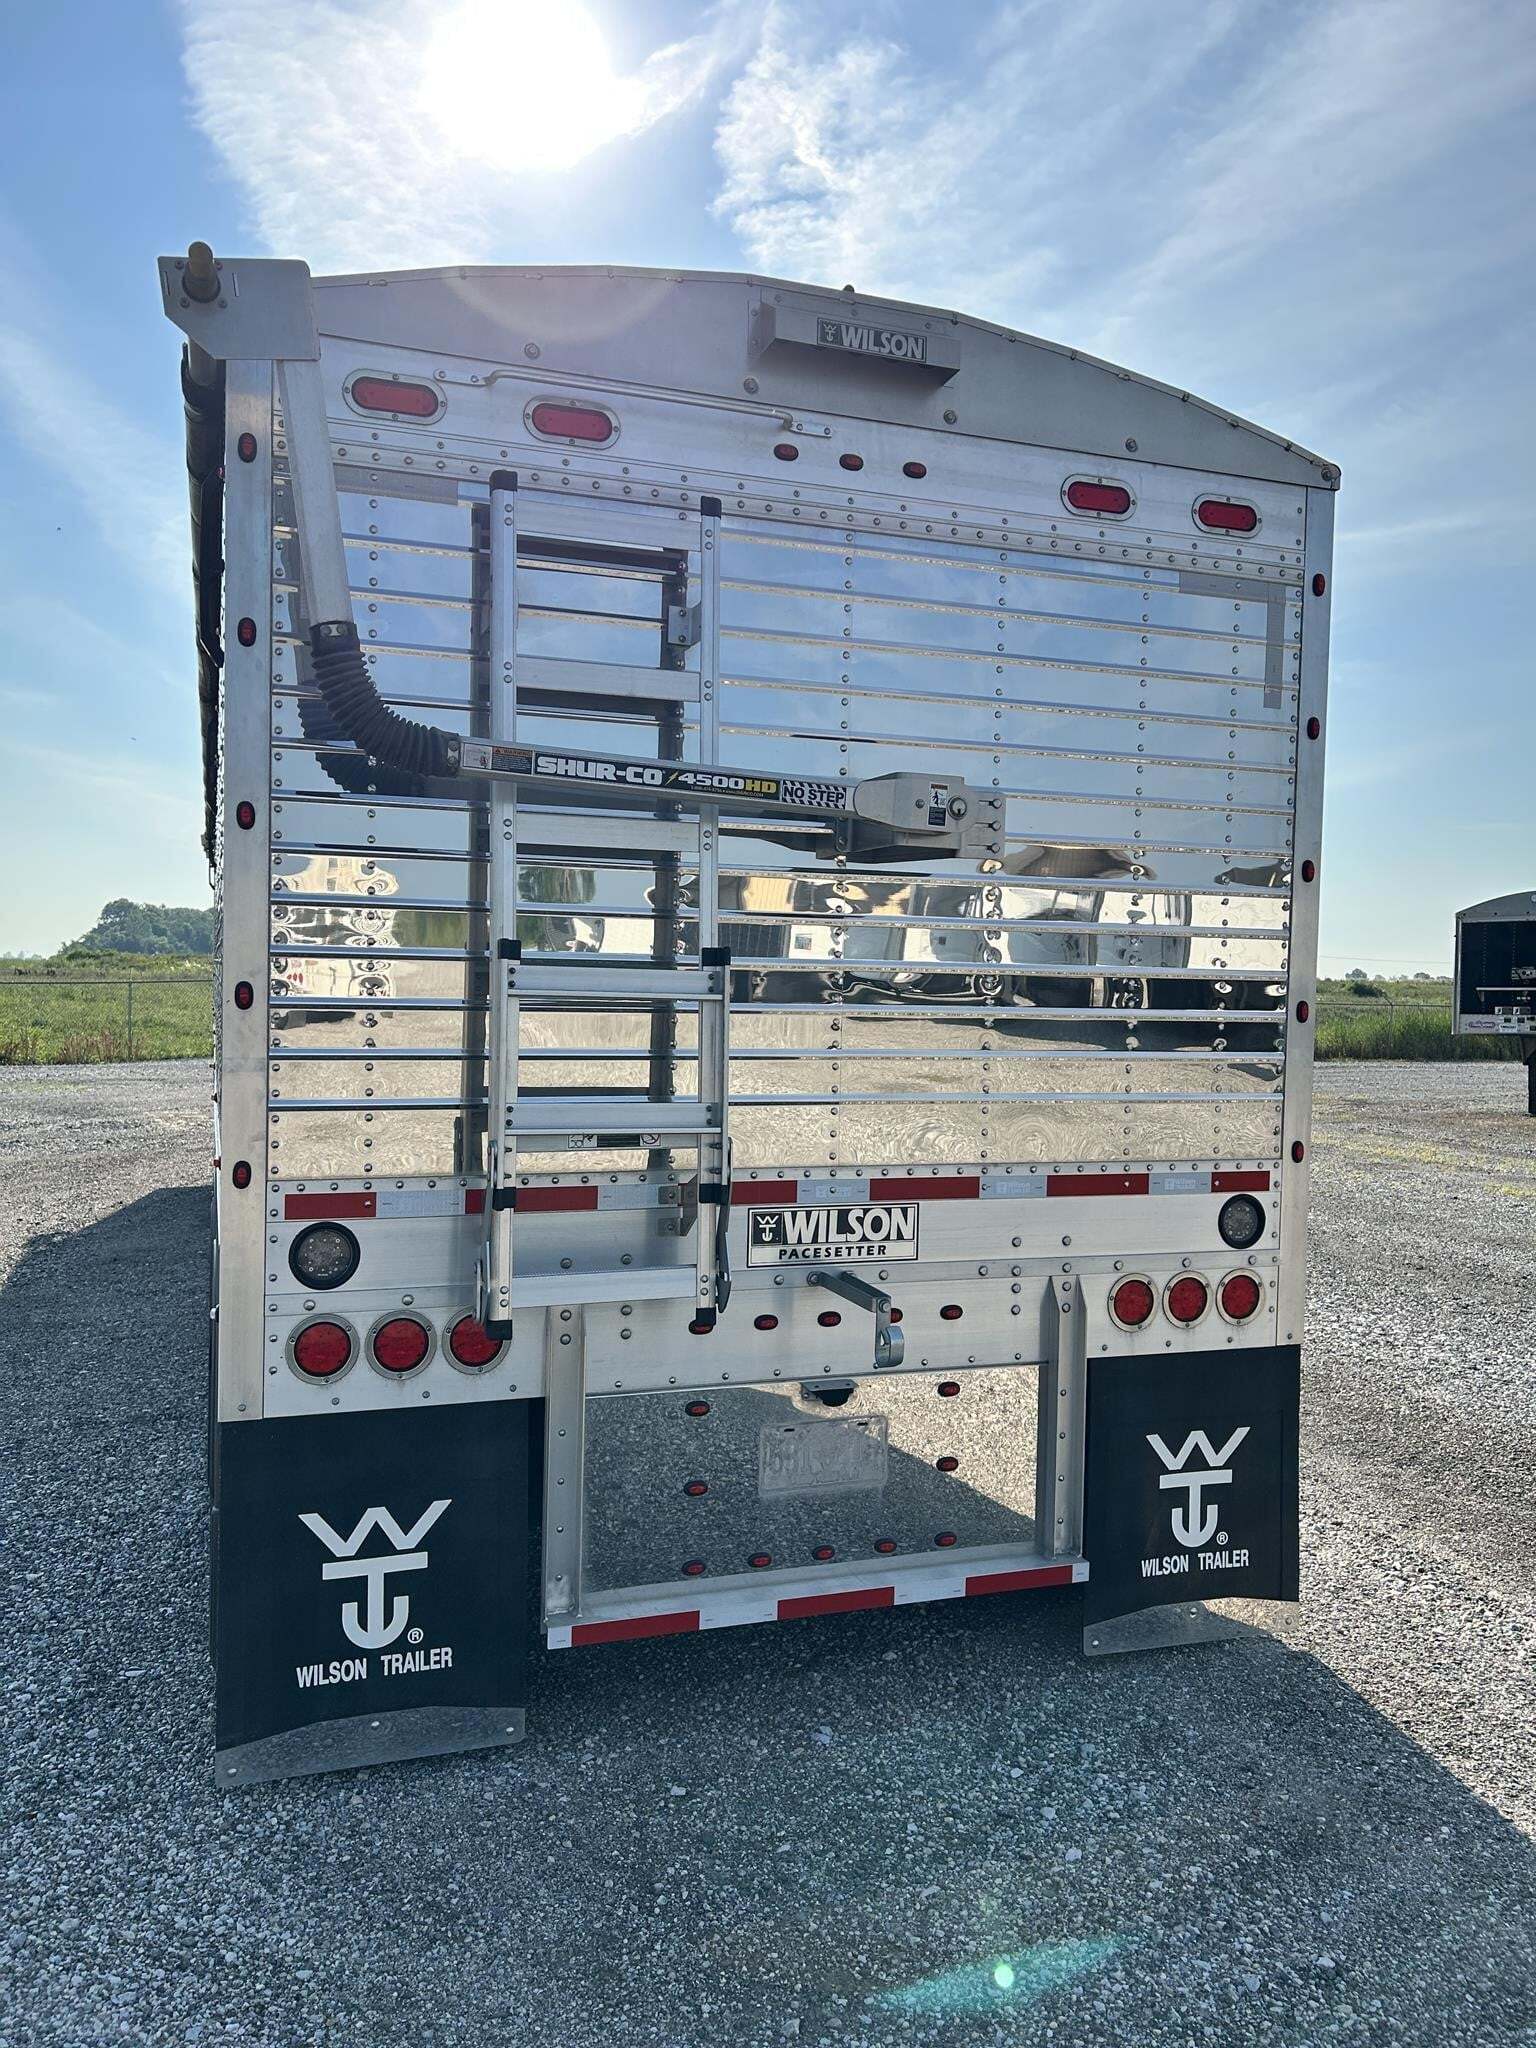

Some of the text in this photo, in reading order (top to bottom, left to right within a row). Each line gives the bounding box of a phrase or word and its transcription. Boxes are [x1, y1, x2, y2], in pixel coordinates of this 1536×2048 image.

[840, 324, 924, 359] WILSON
[536, 756, 663, 786] SHUR-CO
[678, 772, 777, 794] 4500HD
[783, 785, 845, 804] NO STEP
[783, 1207, 915, 1244] WILSON
[778, 1245, 887, 1260] PACESETTER
[1141, 1549, 1250, 1578] WILSON TRAILER
[296, 1646, 453, 1689] WILSON TRAILER
